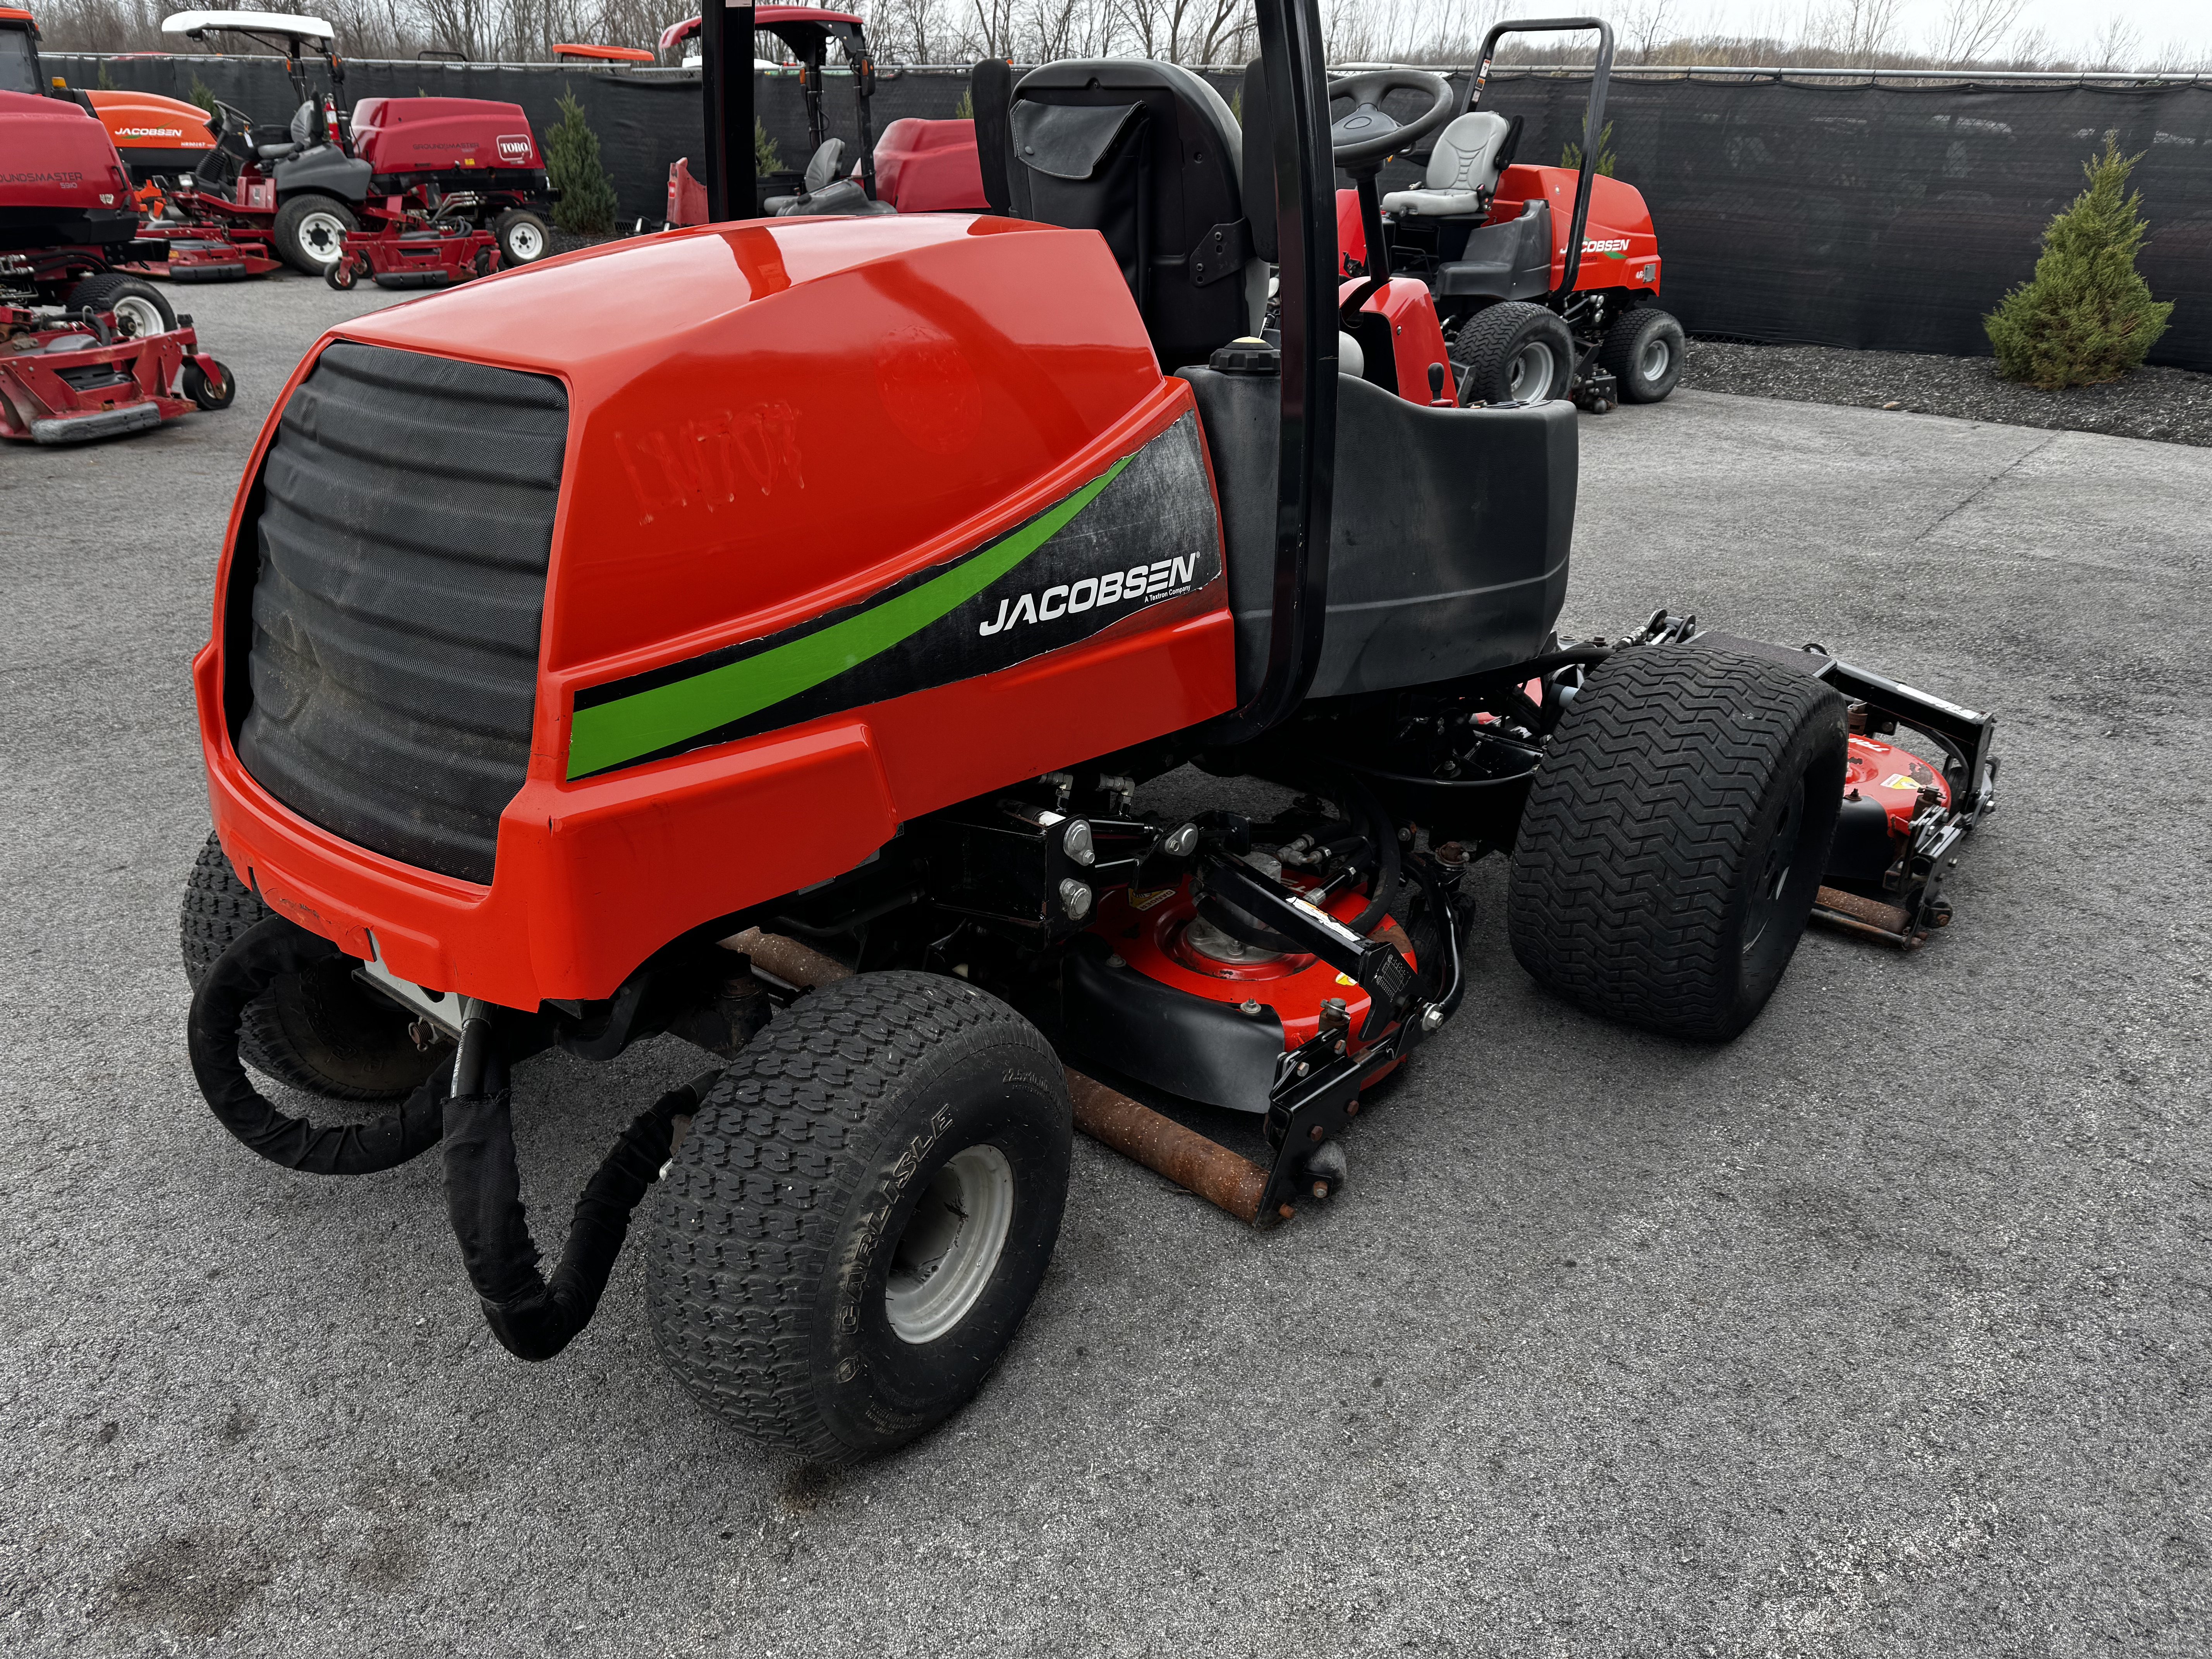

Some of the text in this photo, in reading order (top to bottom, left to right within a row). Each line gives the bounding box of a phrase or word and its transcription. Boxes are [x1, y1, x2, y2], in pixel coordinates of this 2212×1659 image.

[115, 128, 182, 136] JACOBSEN
[500, 142, 529, 153] TORO
[1559, 239, 1630, 254] JCOBSEN
[979, 553, 1196, 636] JACOBSEN
[1149, 592, 1168, 601] Textron
[1169, 585, 1191, 596] Company
[1140, 891, 1173, 910] DANGER
[839, 1103, 953, 1334] CARLISLE
